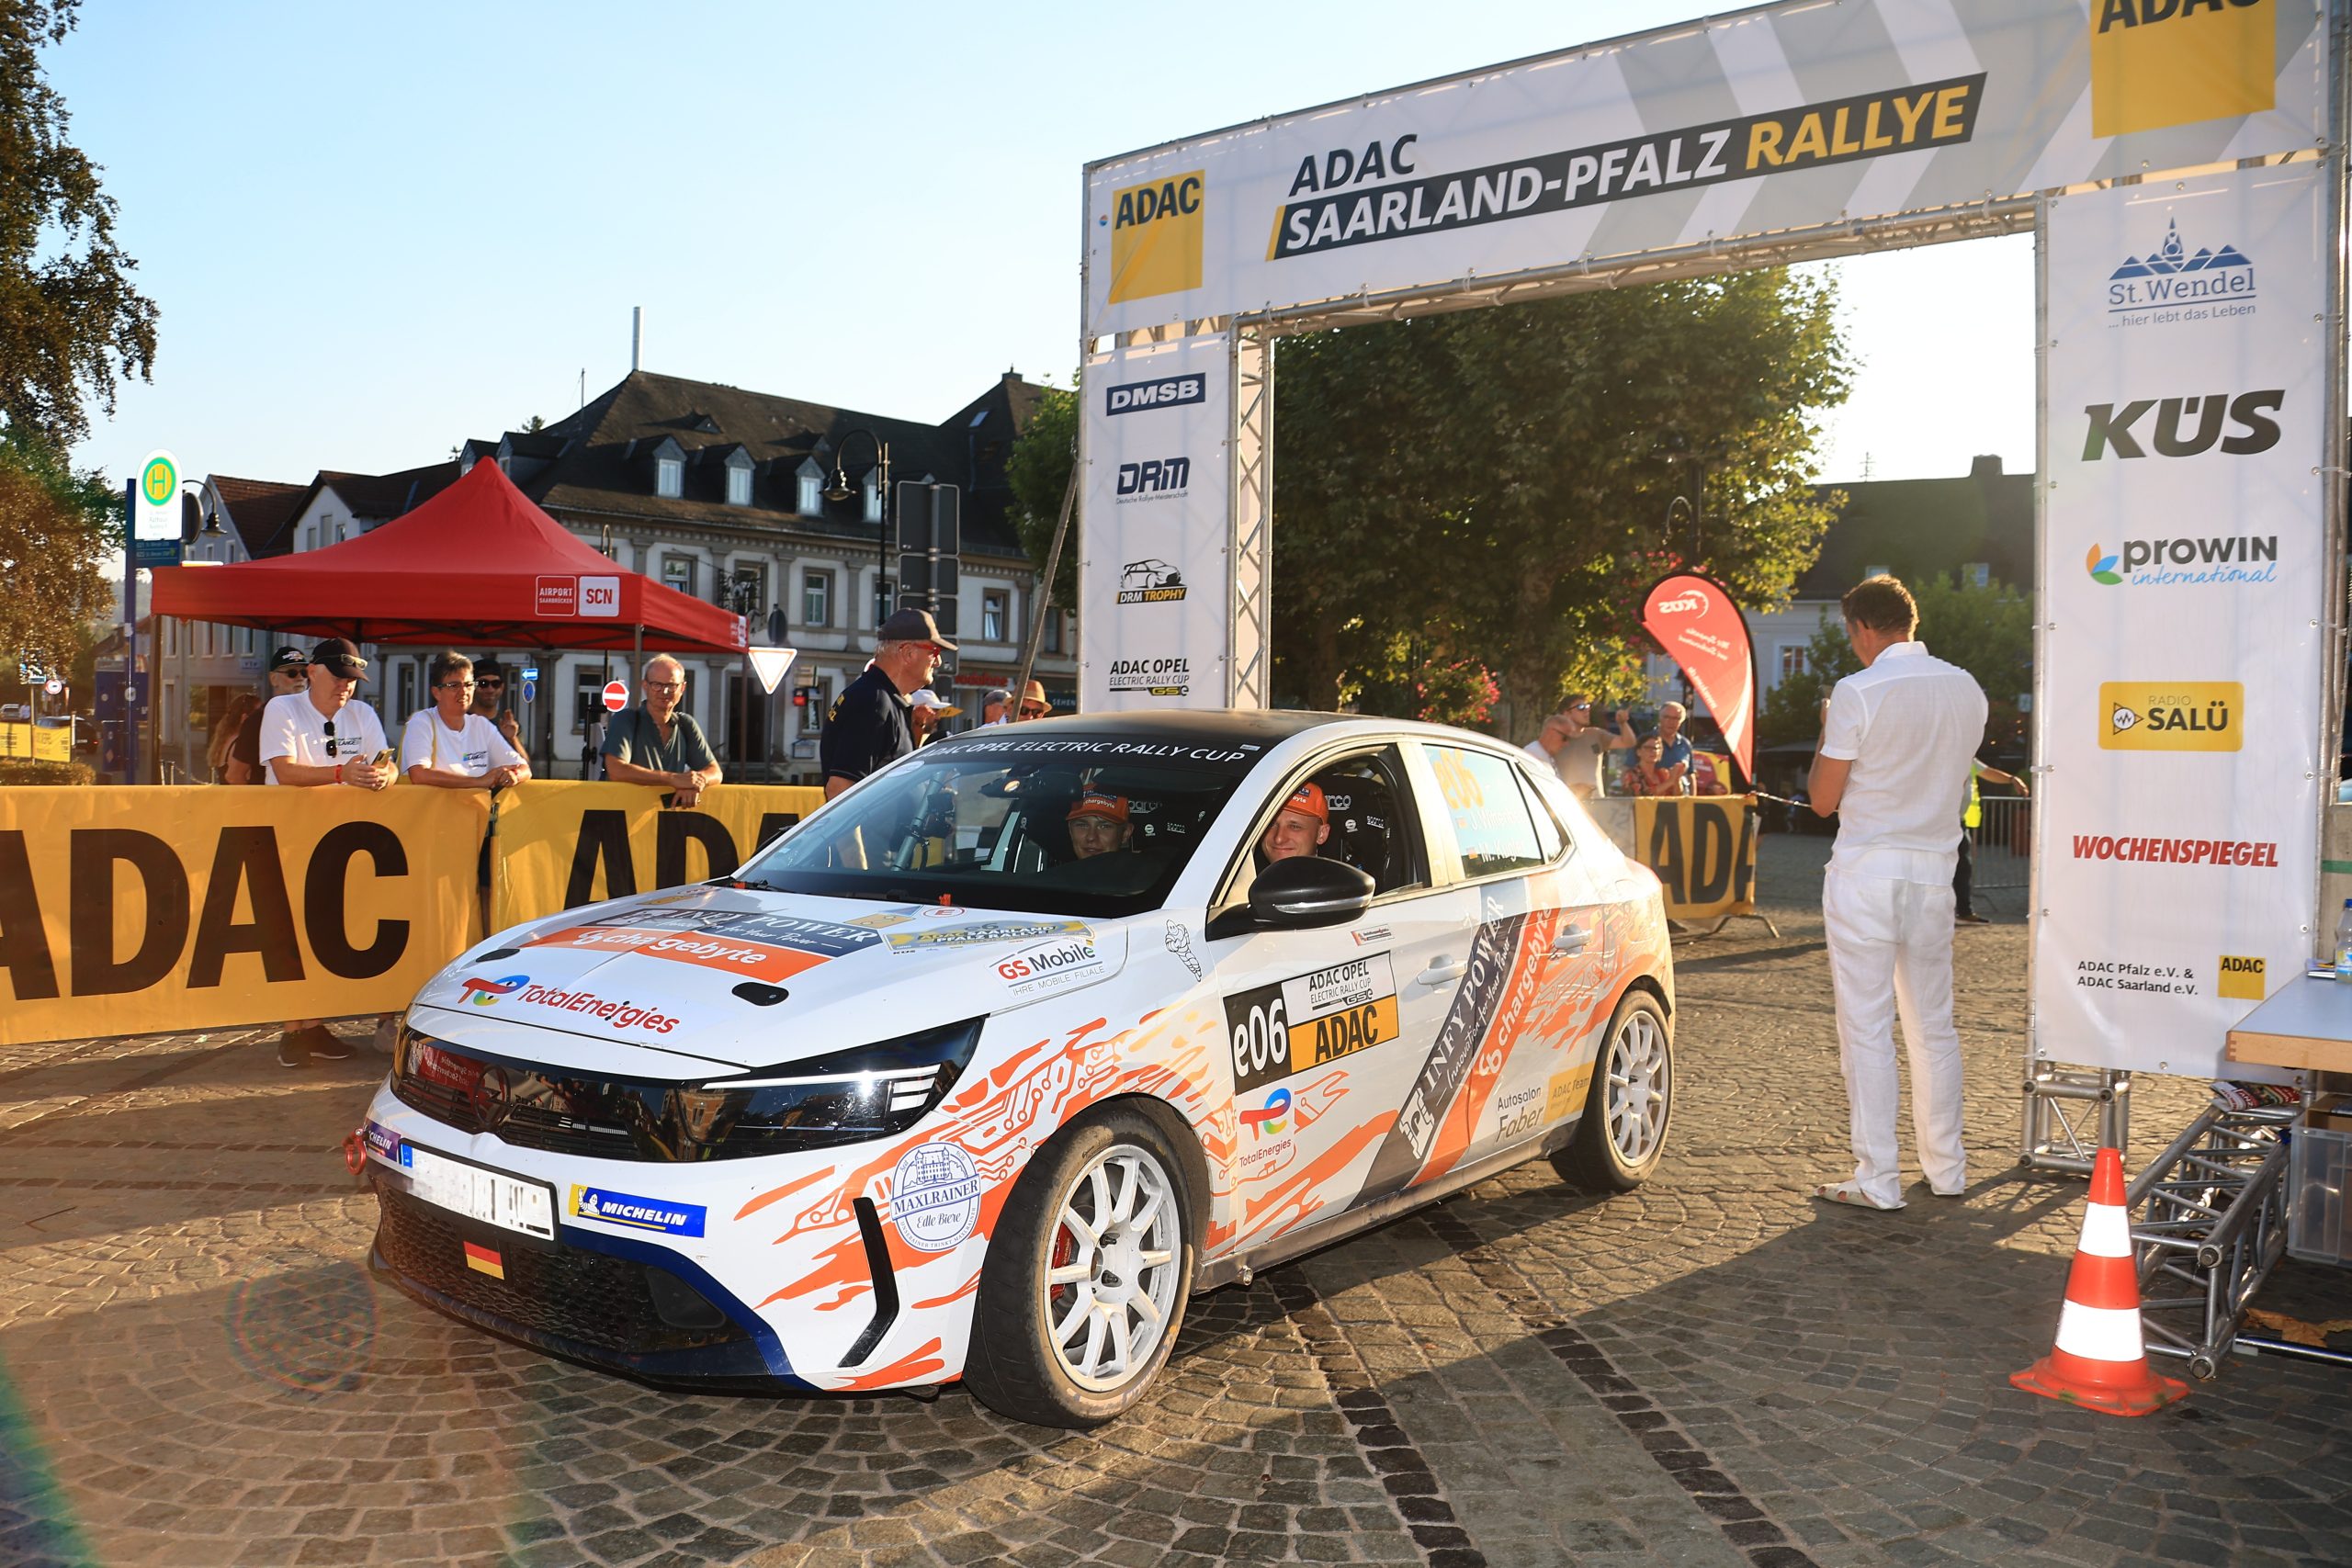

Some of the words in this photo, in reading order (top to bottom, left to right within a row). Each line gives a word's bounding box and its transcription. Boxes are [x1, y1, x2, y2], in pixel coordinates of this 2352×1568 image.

[1286, 130, 1732, 250] SAARLAND-PFALZ
[1747, 85, 1969, 170] RALLYE
[1289, 133, 1418, 197] ADAC
[1115, 176, 1201, 230] ADAC
[2122, 312, 2147, 326] hier
[2154, 310, 2180, 323] lebt
[2184, 308, 2208, 321] das
[2212, 303, 2256, 318] Leben
[1111, 379, 1199, 411] DMSB
[2082, 389, 2285, 461] KÜS
[153, 468, 165, 495] H
[1117, 457, 1190, 495] DRM
[1116, 496, 1137, 505] Deutsche
[2132, 562, 2278, 586] international
[539, 587, 573, 598] AIRPORT
[586, 588, 613, 604] SCN
[1119, 591, 1143, 604] DRM
[1144, 588, 1186, 602] TROPHY
[1110, 660, 1150, 675] ADAC
[1153, 658, 1190, 674] OPEL
[1110, 676, 1145, 686] ELECTRIC
[1146, 675, 1171, 685] RALLY
[1172, 674, 1190, 684] CUP
[2148, 694, 2191, 706] RADIO
[2146, 701, 2228, 732] SALÜ
[966, 742, 1015, 752] OPEL
[1013, 741, 1112, 753] ELECTRIC
[1110, 742, 1189, 758] RALLY
[1189, 749, 1246, 763] CUP
[2073, 835, 2278, 867] WOCHENSPIEGEL
[742, 916, 878, 942] POWER
[936, 934, 986, 942] PFALZ
[966, 926, 1056, 935] SAARLAND
[602, 931, 767, 965] chagebyte
[998, 959, 1031, 980] GS
[1028, 942, 1096, 972] Mobile
[1309, 968, 1340, 992] ADAC
[1341, 960, 1369, 982] OPEL
[1498, 902, 1553, 1046] chargebyte
[2078, 961, 2114, 974] ADAC
[2118, 964, 2150, 977] Pfalz
[2154, 966, 2180, 978] e.V.
[2184, 968, 2194, 979] &
[2221, 957, 2264, 974] ADAC
[1013, 983, 1034, 997] IHRE
[1038, 975, 1071, 989] MOBILE
[1075, 966, 1104, 983] FILIALE
[1310, 987, 1339, 1004] ELECTRIC
[1340, 981, 1358, 995] RALLY
[1359, 977, 1372, 989] CUP
[1424, 1006, 1467, 1091] INFY
[1462, 895, 1505, 1009] POWER
[2077, 976, 2114, 989] ADAC
[2117, 978, 2171, 994] Saarland
[2174, 983, 2199, 996] e.V.
[517, 984, 680, 1034] TotalEnergies
[1445, 1024, 1481, 1089] Innovation
[1477, 1001, 1489, 1027] for
[1485, 973, 1501, 1003] Your
[1493, 936, 1510, 971] Power
[1233, 998, 1287, 1077] e06
[1315, 1004, 1378, 1065] ADAC
[1497, 1087, 1542, 1111] Autosalon
[1496, 1106, 1544, 1144] Faber
[1238, 1138, 1292, 1168] TotalEnergies
[894, 1179, 978, 1215] MAXLRAINER
[602, 1201, 687, 1227] MICHELIN
[916, 1214, 939, 1229] Edle
[938, 1212, 961, 1224] Biere
